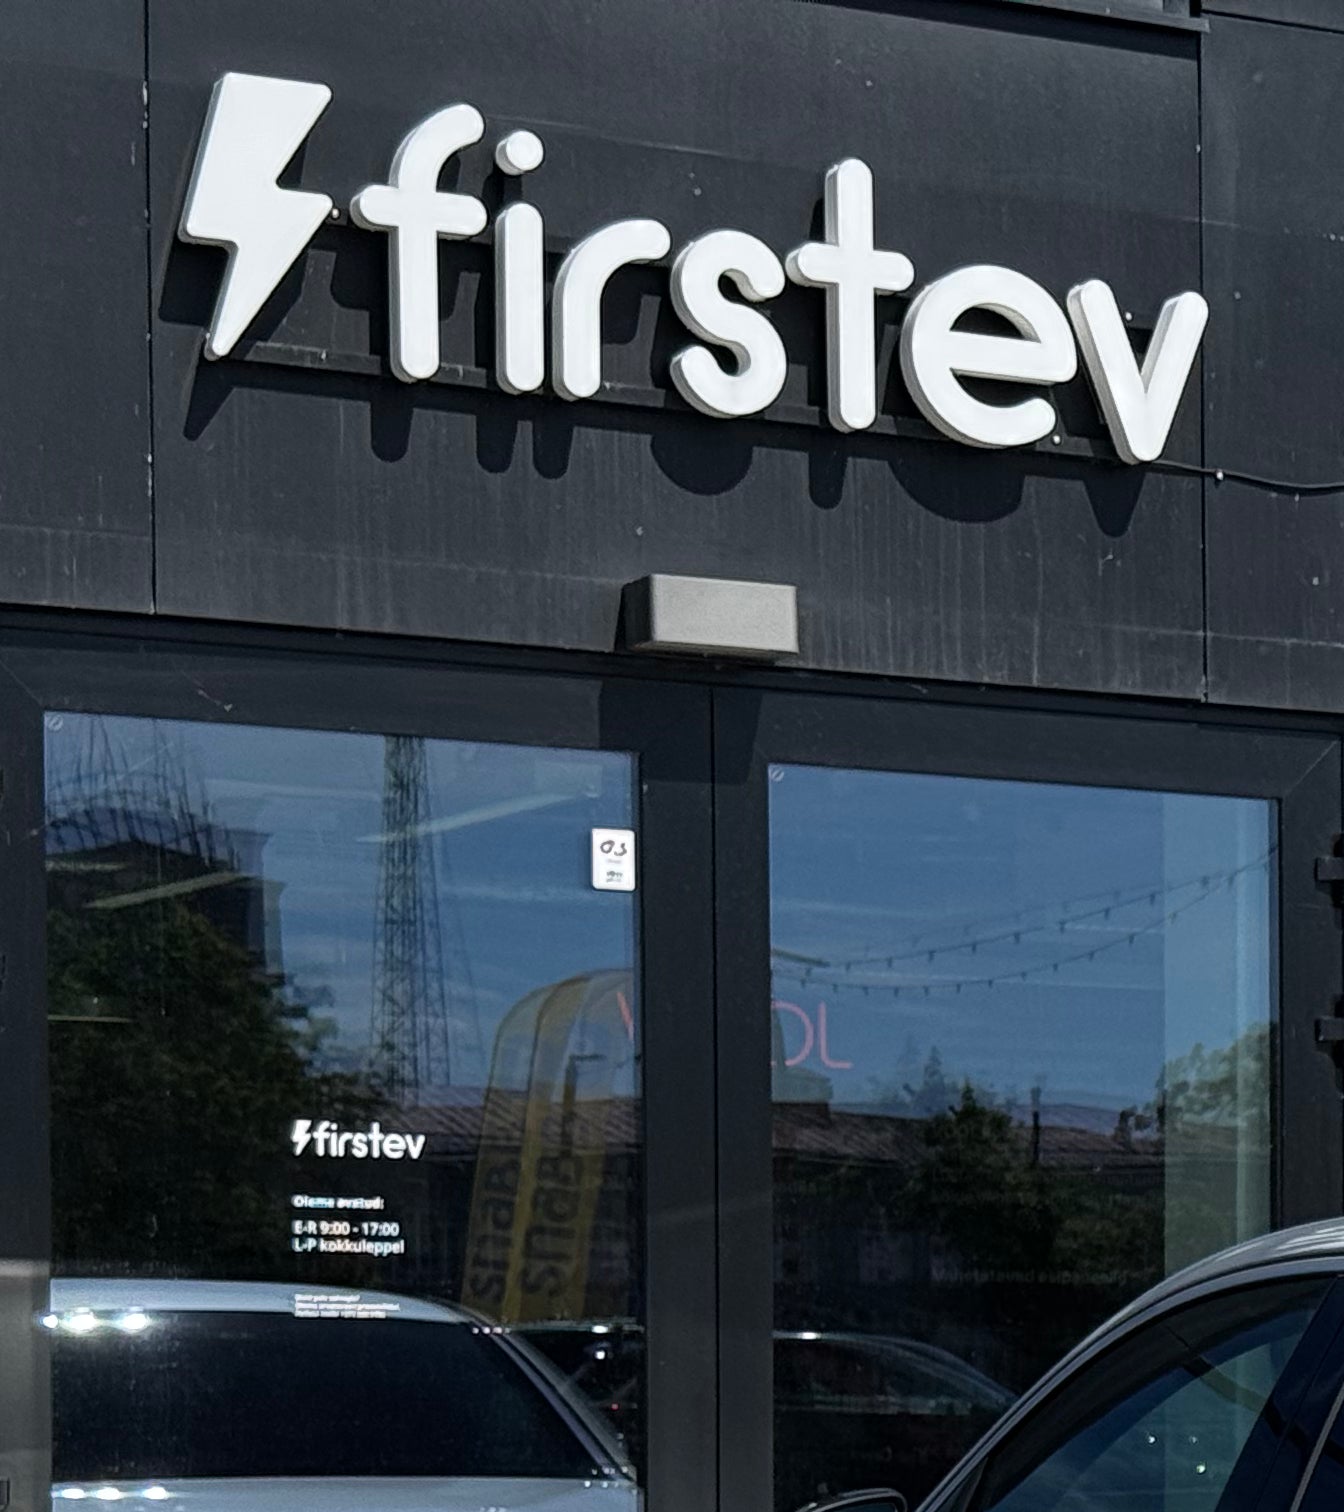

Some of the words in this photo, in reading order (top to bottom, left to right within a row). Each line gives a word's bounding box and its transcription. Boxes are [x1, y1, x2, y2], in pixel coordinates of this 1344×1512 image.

[349, 103, 1208, 464] firstev
[313, 1120, 426, 1159] firstev
[319, 1219, 351, 1236] 9:00
[361, 1221, 401, 1237] 17:00
[319, 1237, 405, 1258] kokkuleppel
